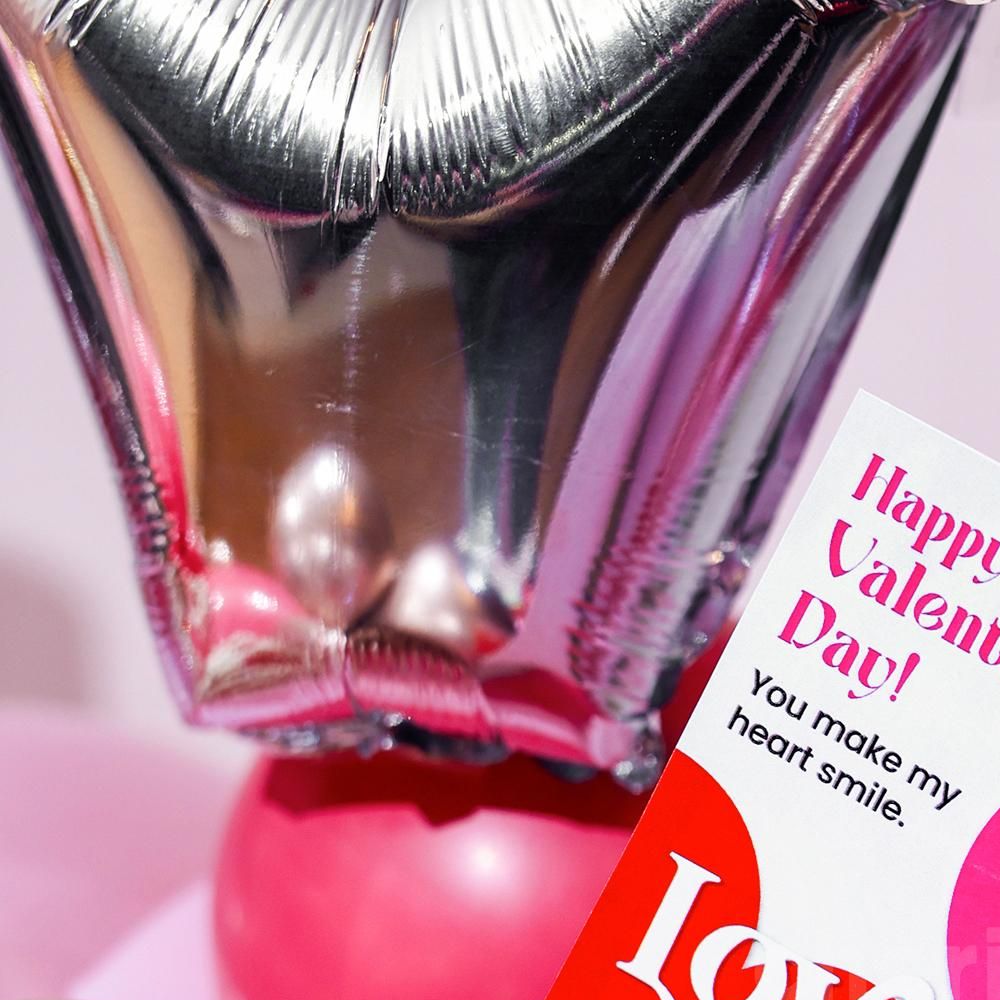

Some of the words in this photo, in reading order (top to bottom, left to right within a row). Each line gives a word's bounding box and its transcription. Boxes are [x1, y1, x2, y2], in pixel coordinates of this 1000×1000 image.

[778, 590, 921, 702] Day!
[727, 705, 814, 773] heart
[816, 760, 905, 828] smile.
[752, 668, 808, 721] You
[812, 708, 902, 773] make
[907, 763, 962, 810] my
